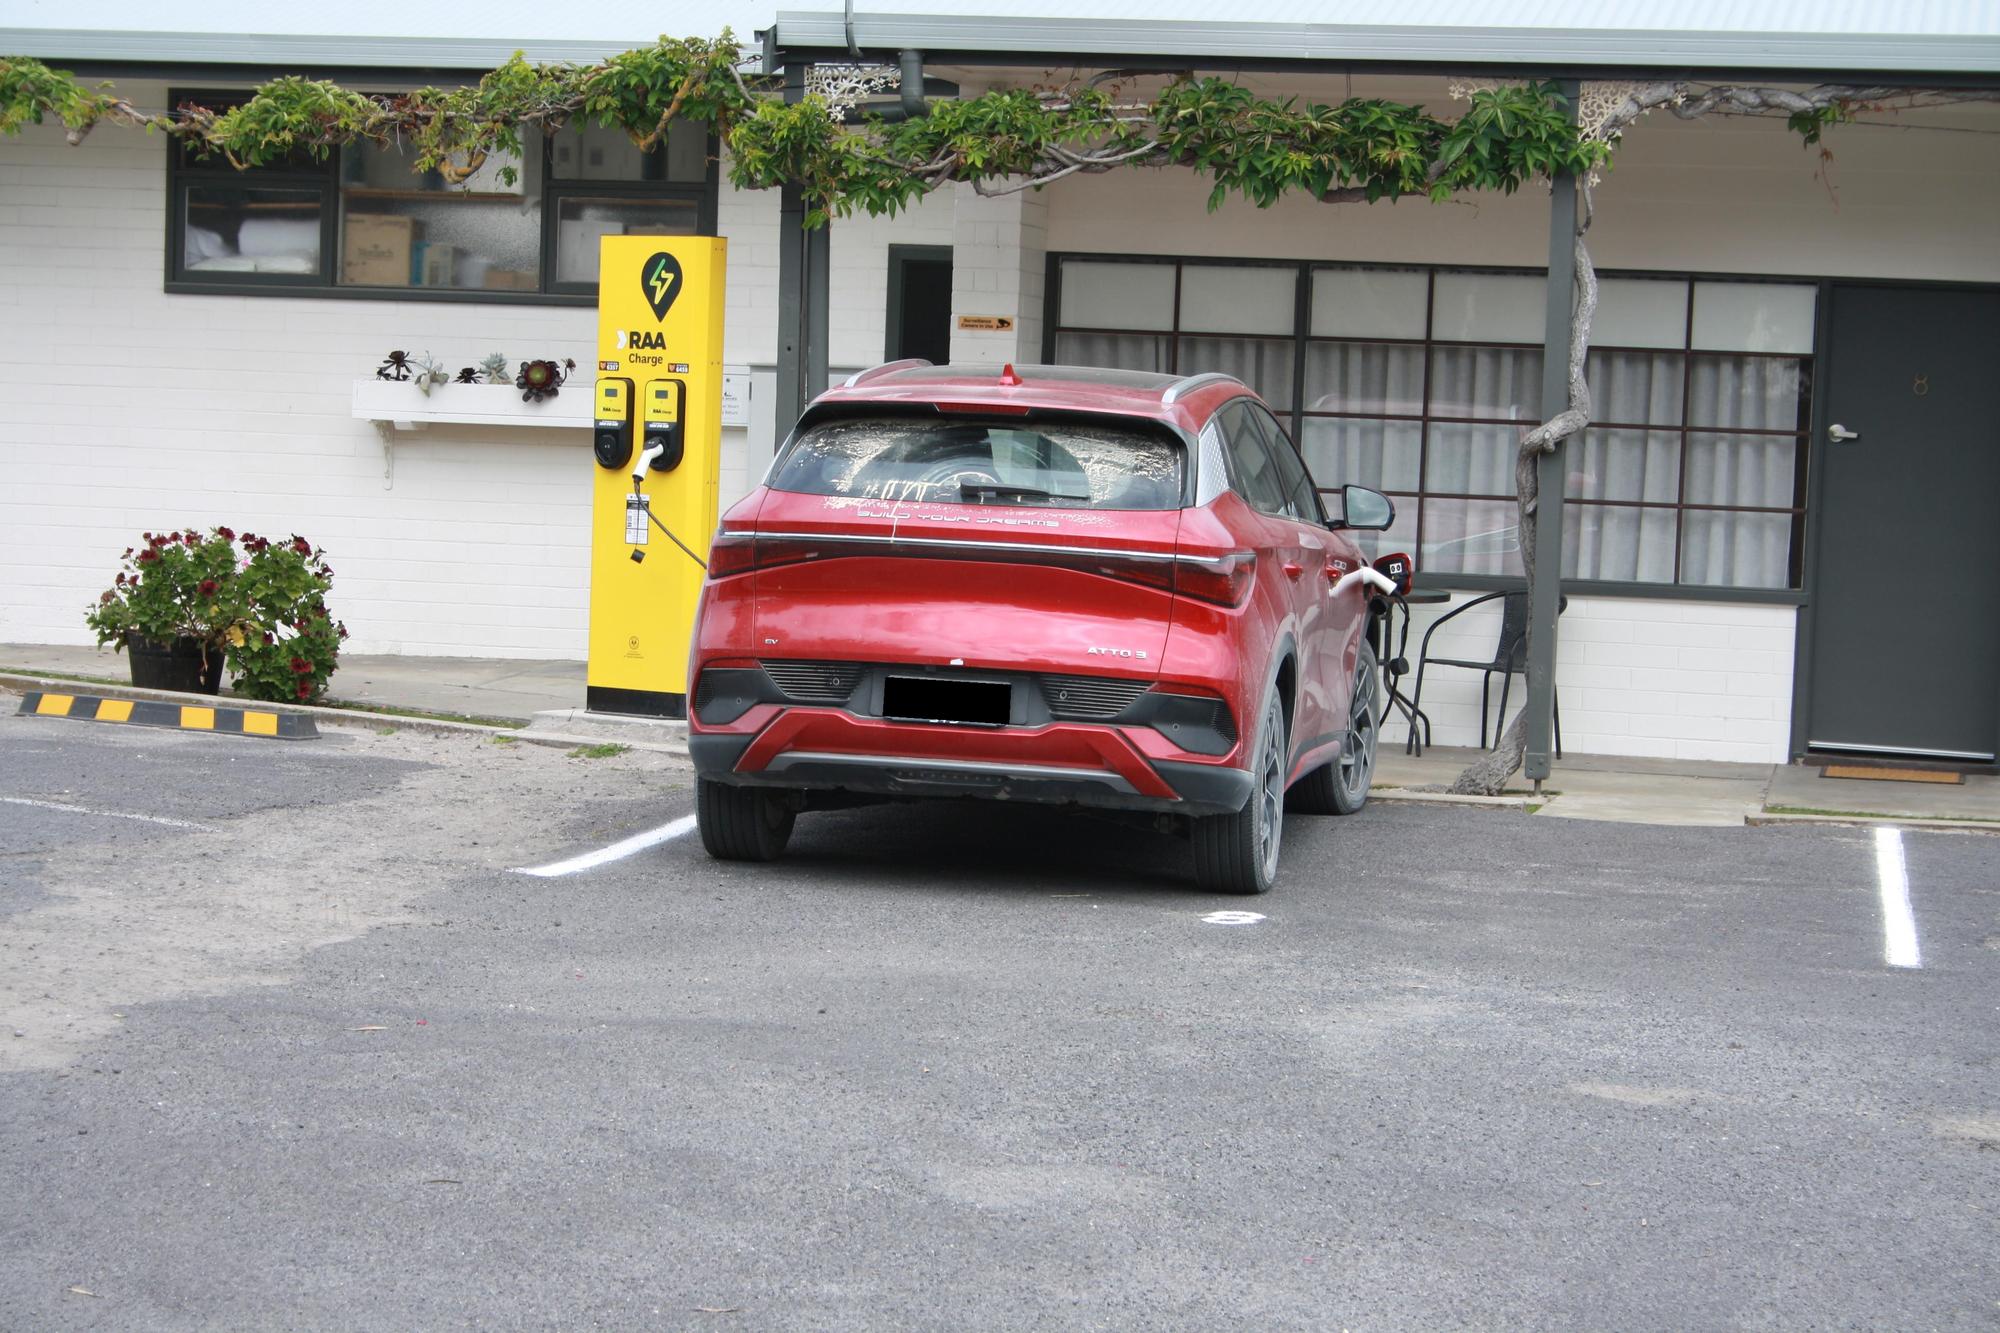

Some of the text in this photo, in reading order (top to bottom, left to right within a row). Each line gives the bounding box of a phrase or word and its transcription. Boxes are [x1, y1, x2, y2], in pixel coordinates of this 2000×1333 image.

[629, 331, 667, 350] RAA
[628, 353, 663, 367] Charge
[1912, 373, 1929, 396] 8
[857, 510, 1060, 528] BUILD YOUR DREAMS
[1087, 647, 1147, 660] ATTO 3
